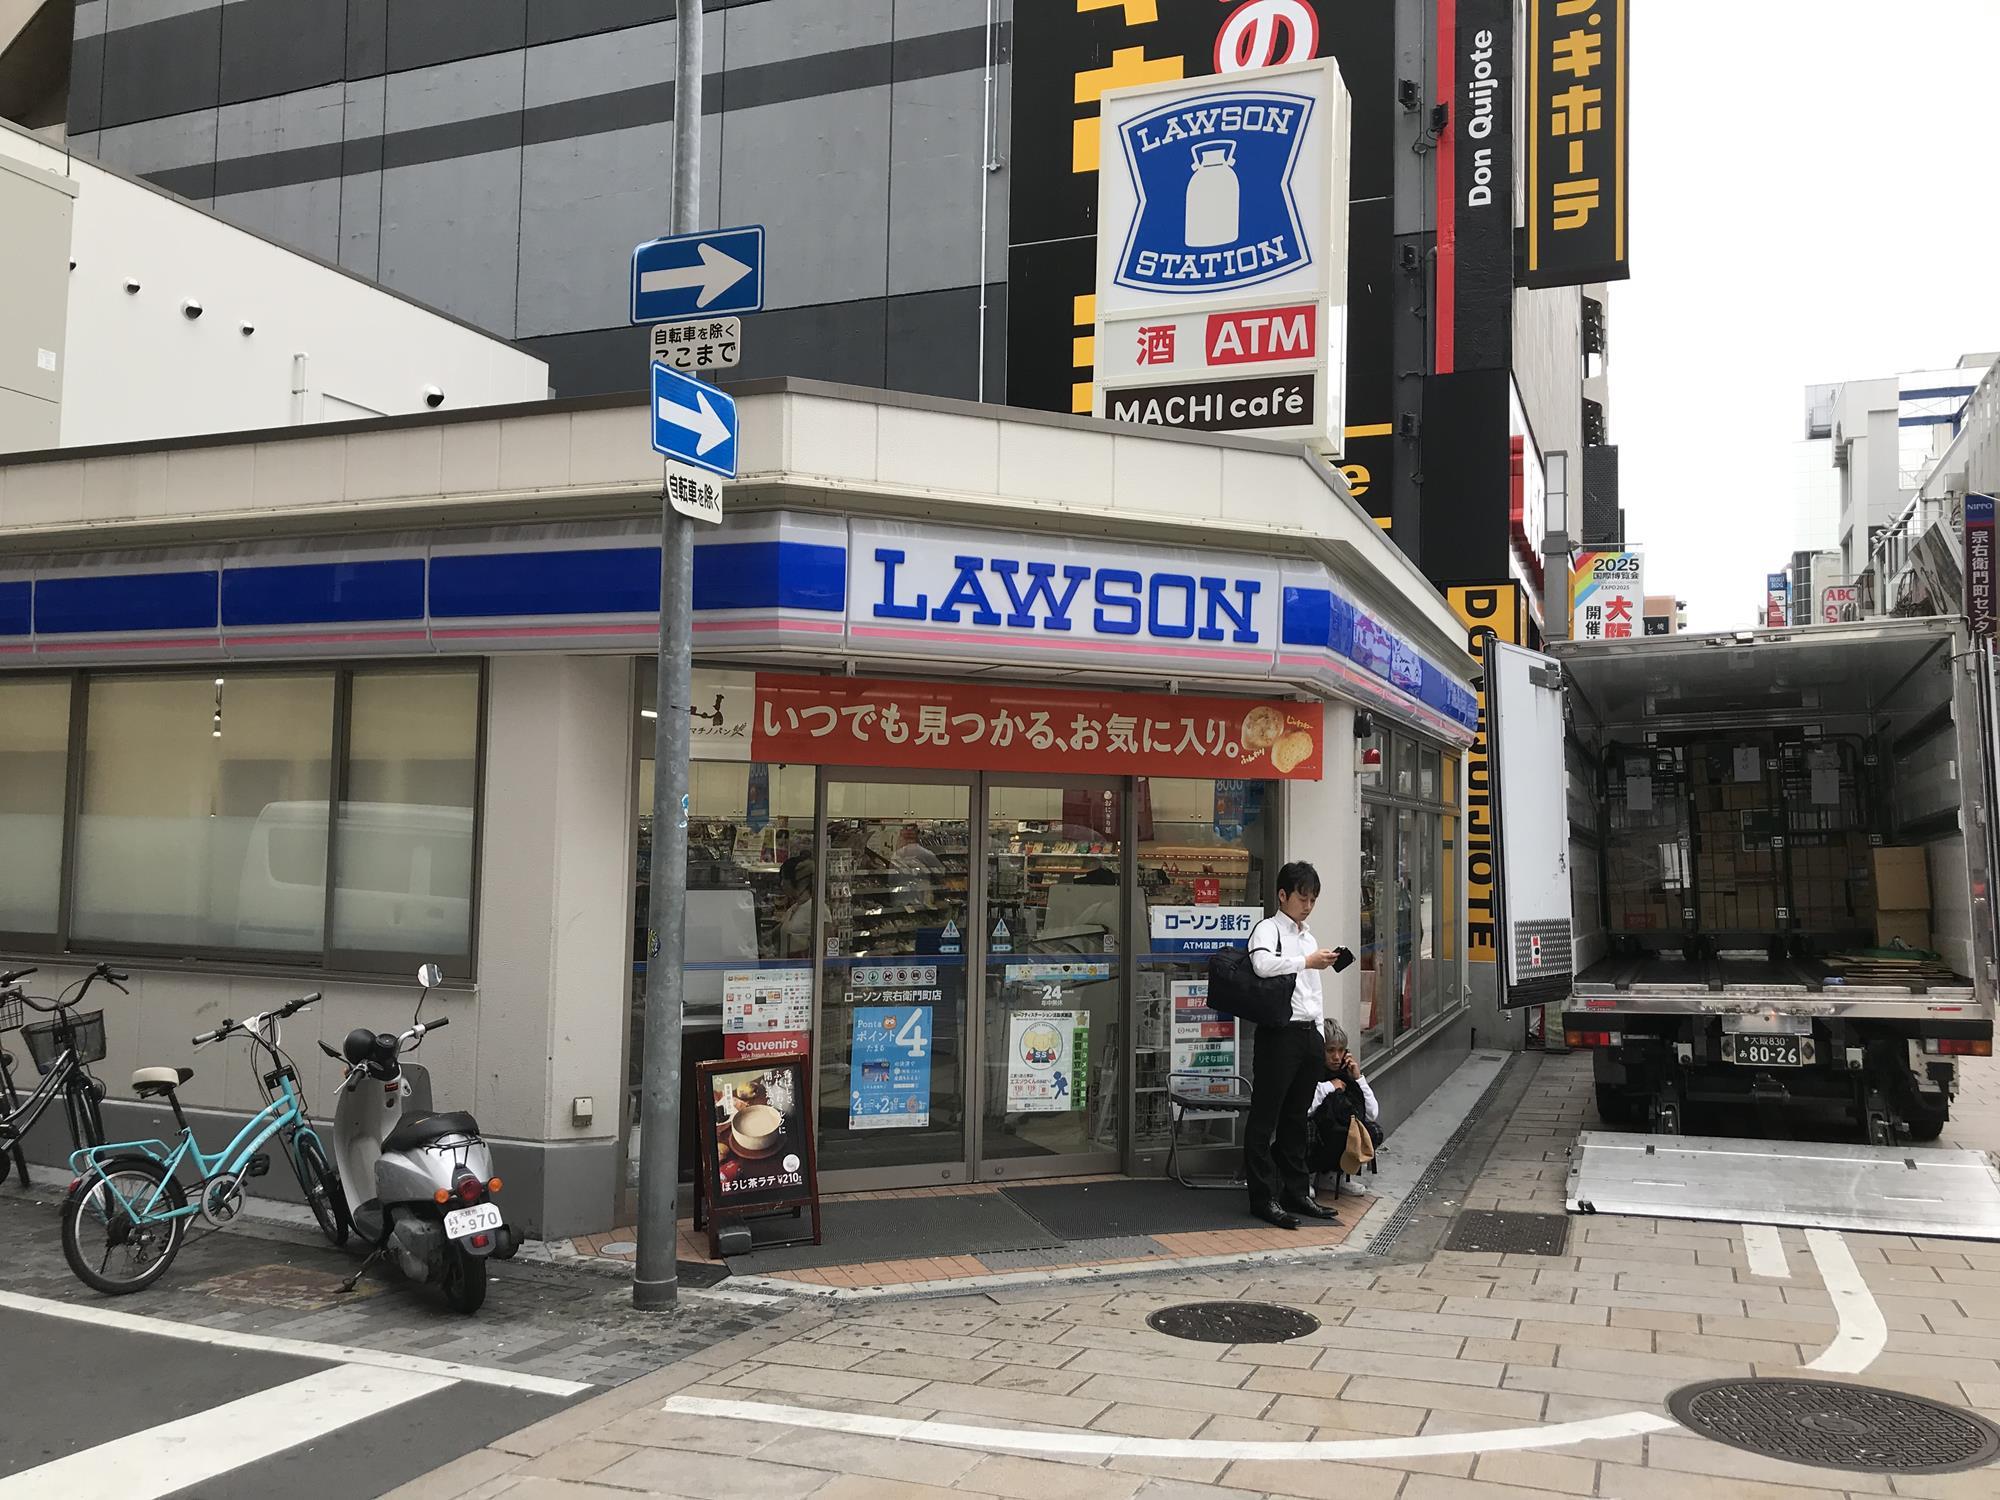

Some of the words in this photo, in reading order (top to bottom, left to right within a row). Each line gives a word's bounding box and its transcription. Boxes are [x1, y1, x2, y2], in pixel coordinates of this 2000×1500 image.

[1468, 29, 1498, 139] Quijote
[1136, 105, 1294, 152] LAWSON
[1468, 148, 1491, 207] Don
[1135, 235, 1288, 279] STATION
[654, 322, 736, 345] 自転車を除く
[1136, 324, 1176, 366] 酒
[1211, 314, 1309, 358] ATM
[1114, 393, 1223, 424] MACHI
[1230, 387, 1304, 418] café
[669, 473, 720, 512] 自転車を除く
[1594, 559, 1640, 571] 2025
[873, 547, 1262, 644] LAWSON
[1826, 589, 1856, 601] ABC
[1586, 605, 1601, 640] 開催
[763, 700, 1239, 758] いつでも見つかる、お気に入り。
[1165, 914, 1251, 931] ローソン銀行
[1042, 984, 1062, 1000] 24
[856, 1030, 895, 1042] ポイント
[857, 1020, 882, 1028] Ponta
[895, 1007, 928, 1057] 4
[737, 1038, 798, 1051] Souvenirs
[1749, 1047, 1797, 1063] 80-26
[721, 1175, 776, 1192] ほうじ茶ラテ
